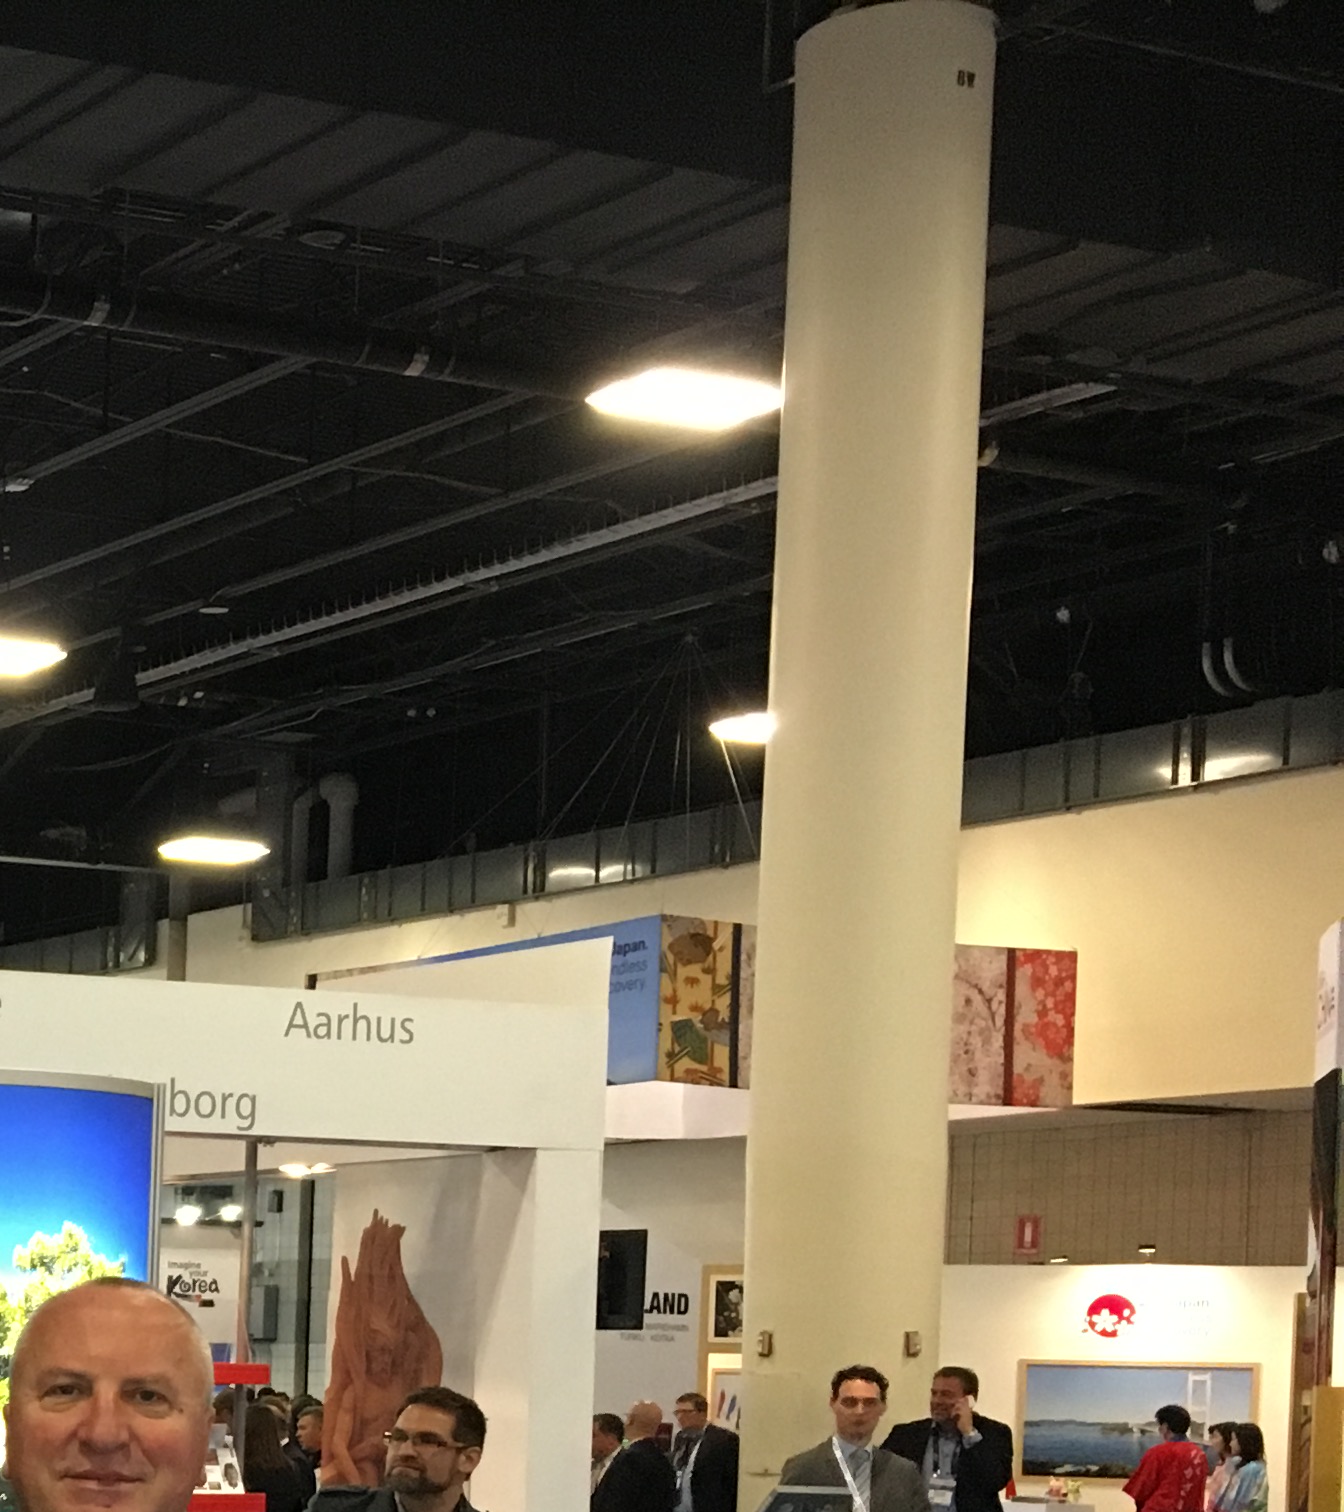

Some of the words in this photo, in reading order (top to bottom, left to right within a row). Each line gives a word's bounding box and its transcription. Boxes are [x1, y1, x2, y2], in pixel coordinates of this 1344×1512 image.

[283, 1000, 415, 1045] Aarhus
[168, 1077, 257, 1132] borg
[166, 1274, 220, 1297] Korea
